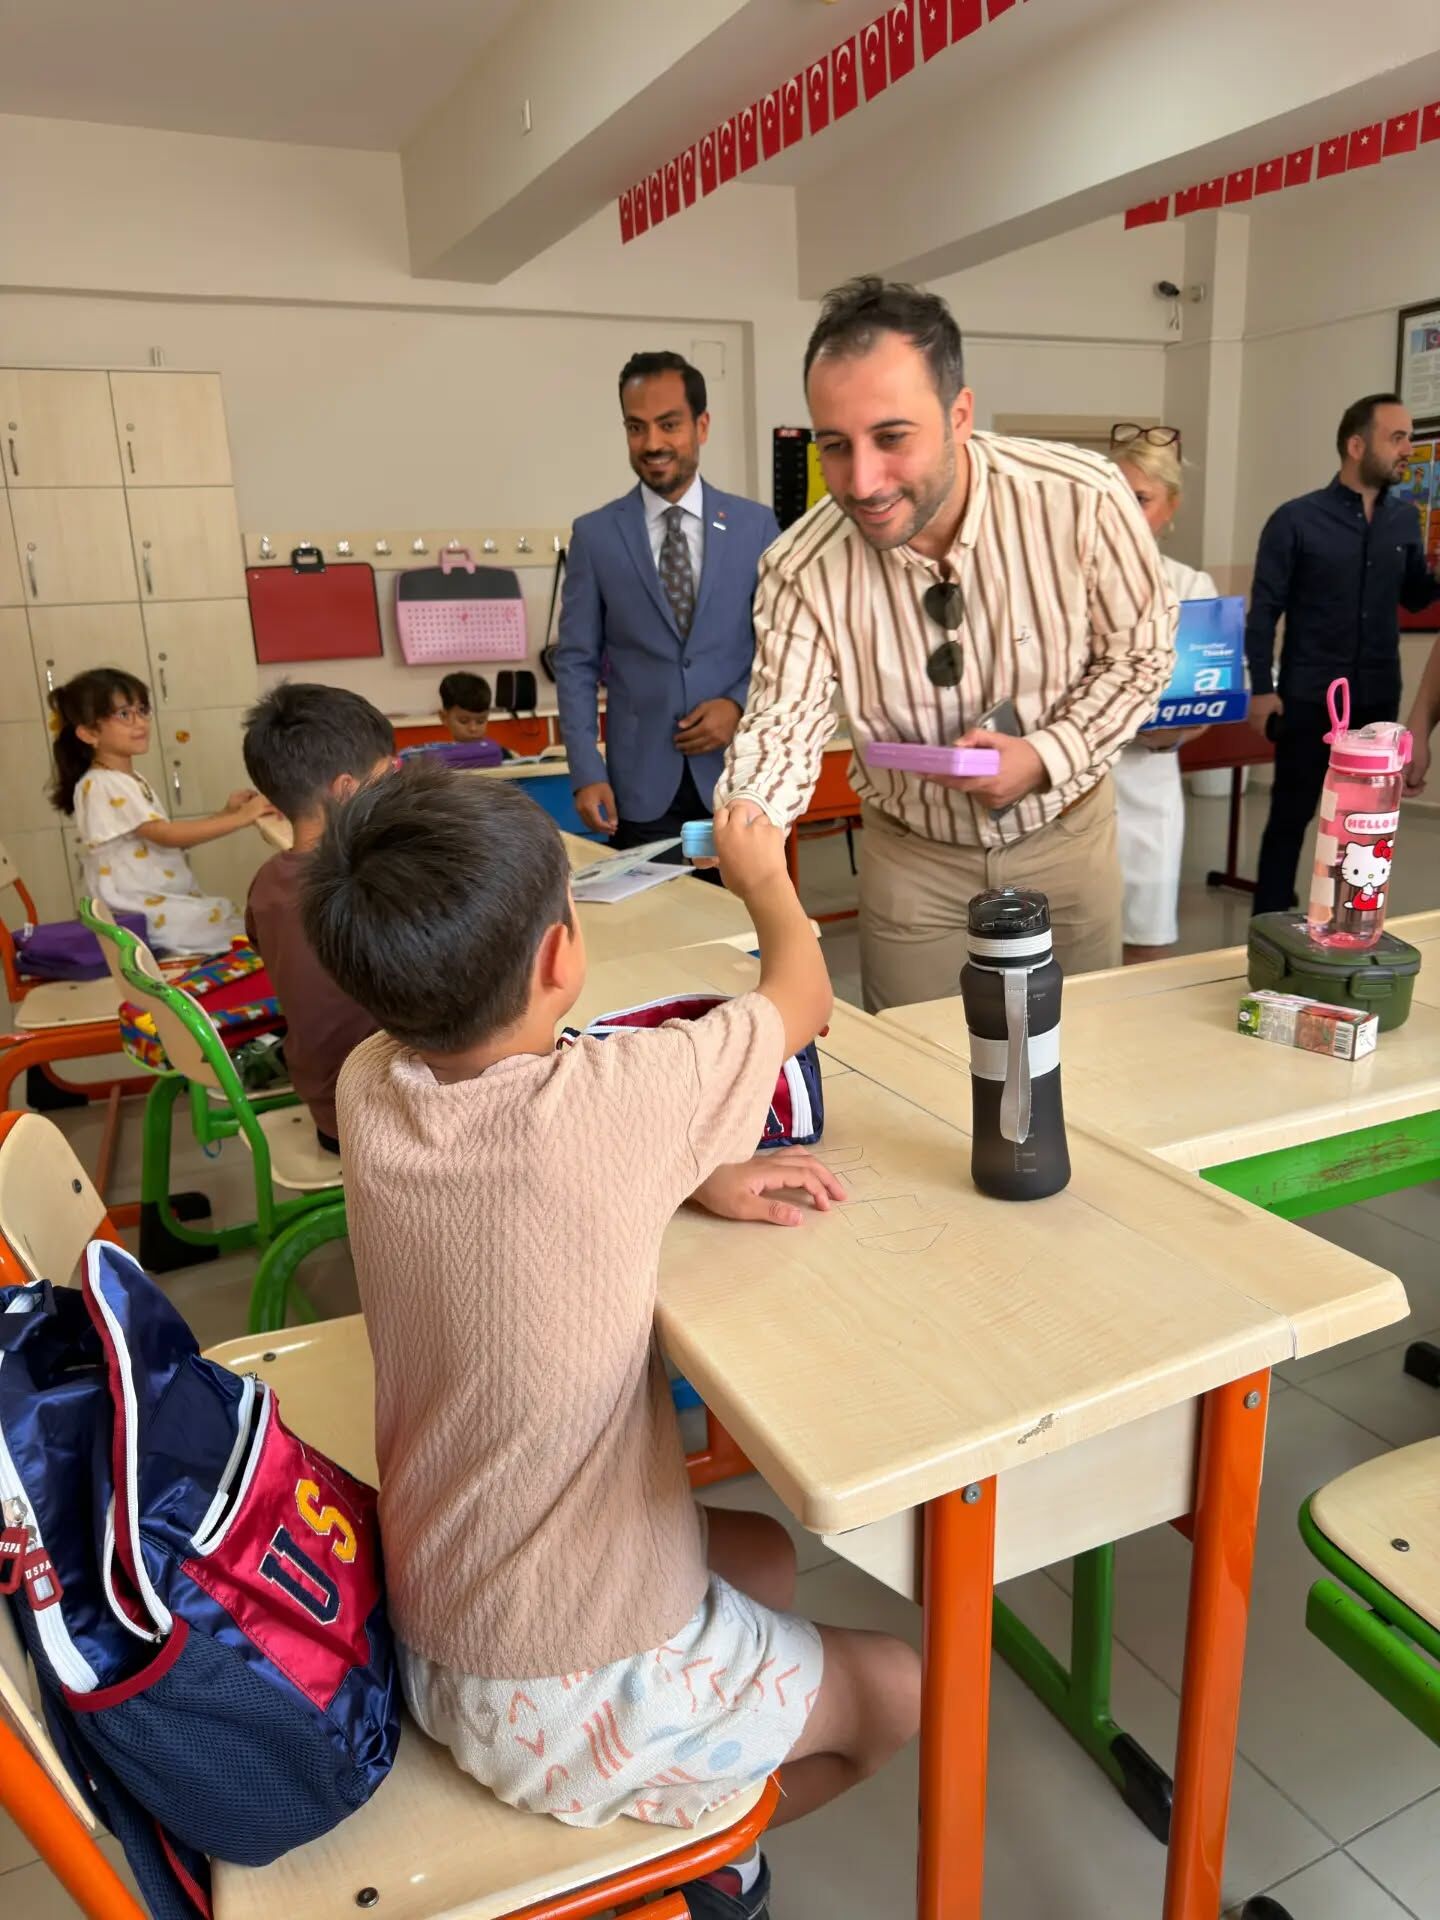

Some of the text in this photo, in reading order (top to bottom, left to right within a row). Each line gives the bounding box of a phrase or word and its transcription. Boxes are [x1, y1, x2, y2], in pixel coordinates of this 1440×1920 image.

[1150, 700, 1227, 723] Doubl
[1347, 819, 1390, 829] HELLO
[24, 1560, 52, 1580] USPA
